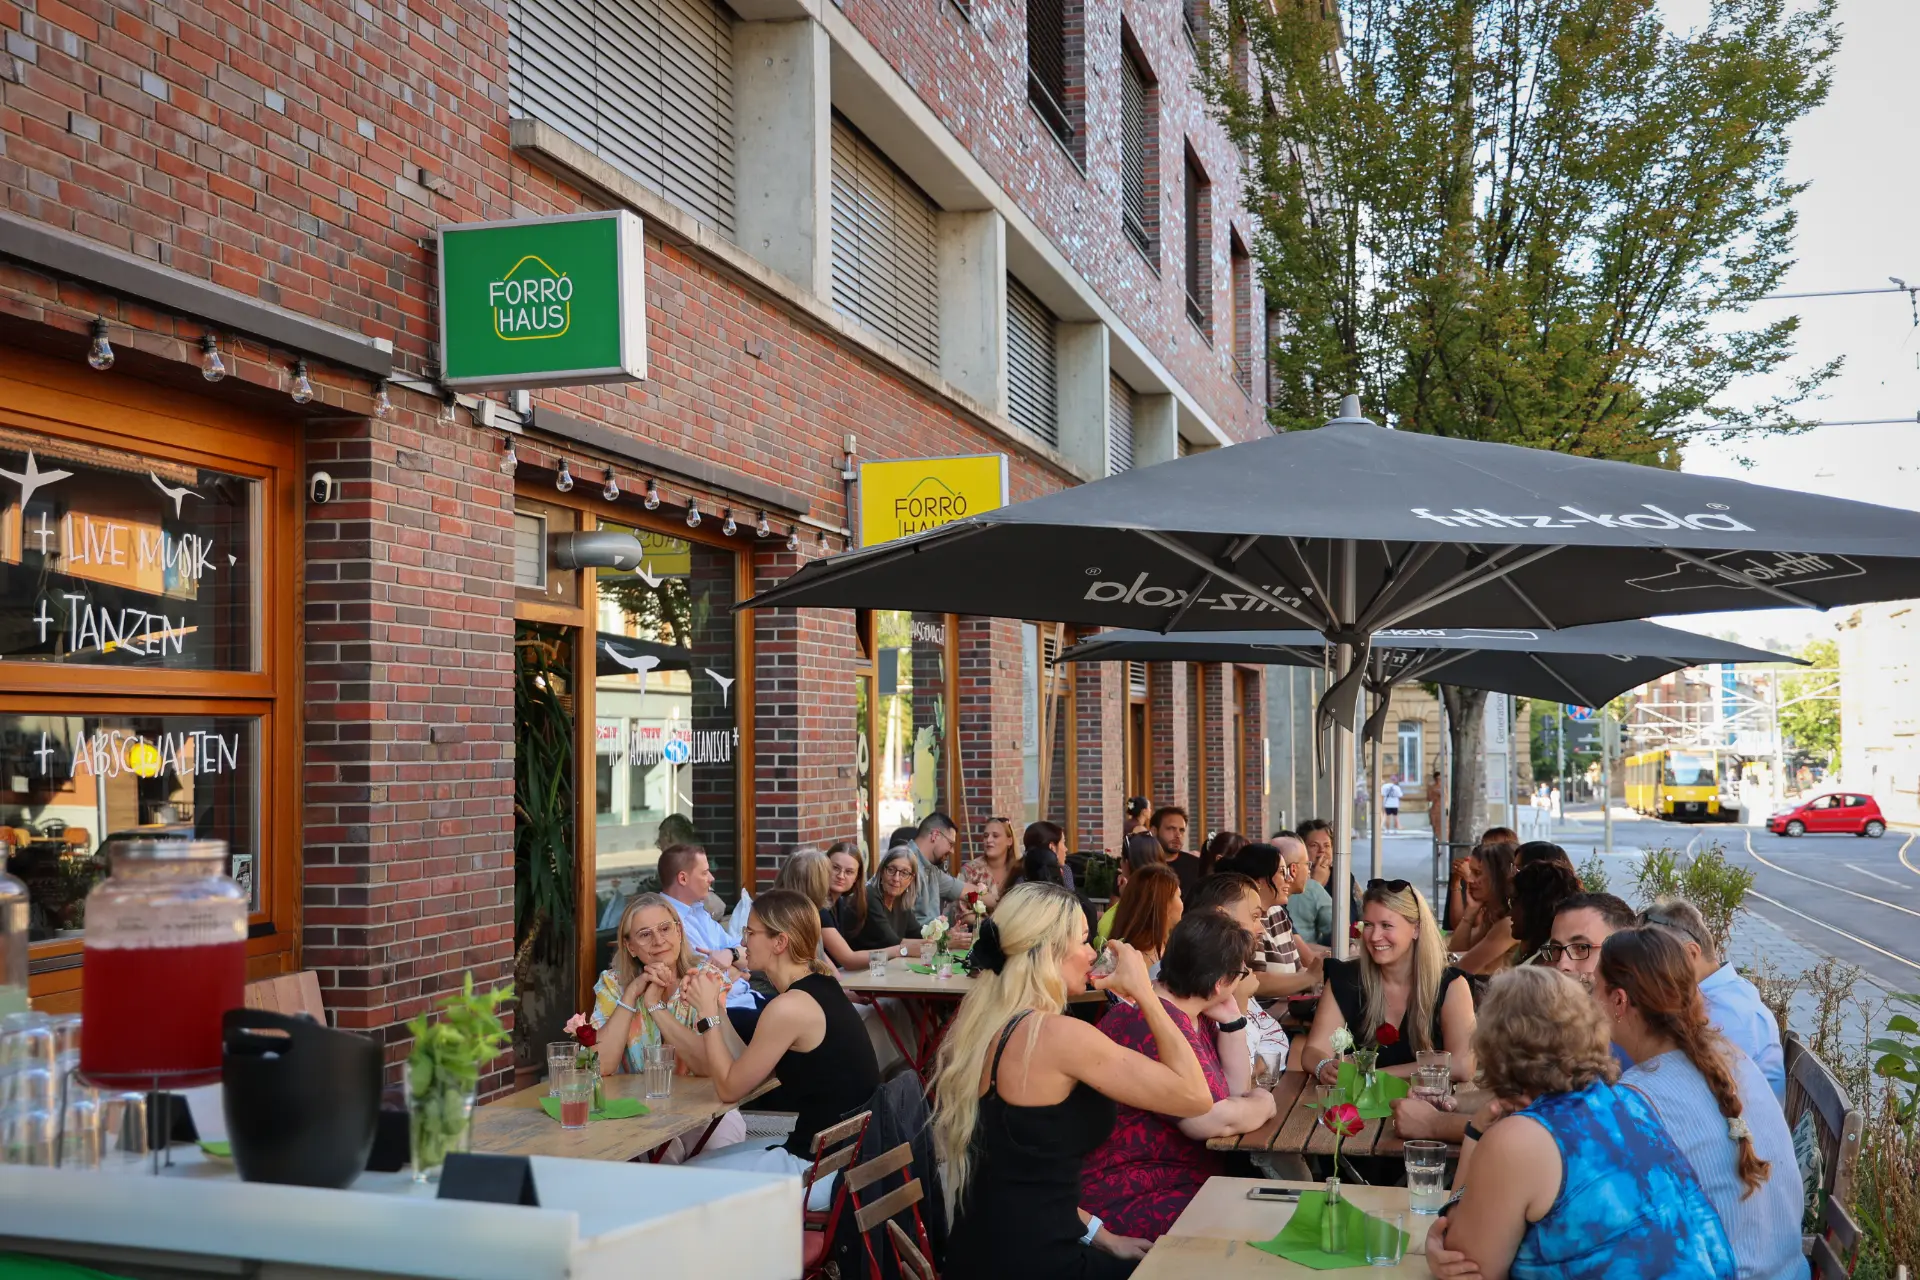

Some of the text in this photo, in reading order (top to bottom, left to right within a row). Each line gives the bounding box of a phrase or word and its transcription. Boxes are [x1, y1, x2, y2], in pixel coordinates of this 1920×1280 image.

[489, 271, 573, 307] FORRÓ
[500, 305, 565, 332] HAUS
[895, 492, 967, 519] FORRÓ
[68, 513, 129, 566] LIVE
[139, 530, 217, 580] MUSIK
[63, 594, 186, 657] TANZEN
[70, 729, 239, 779] ABSCHALTEN
